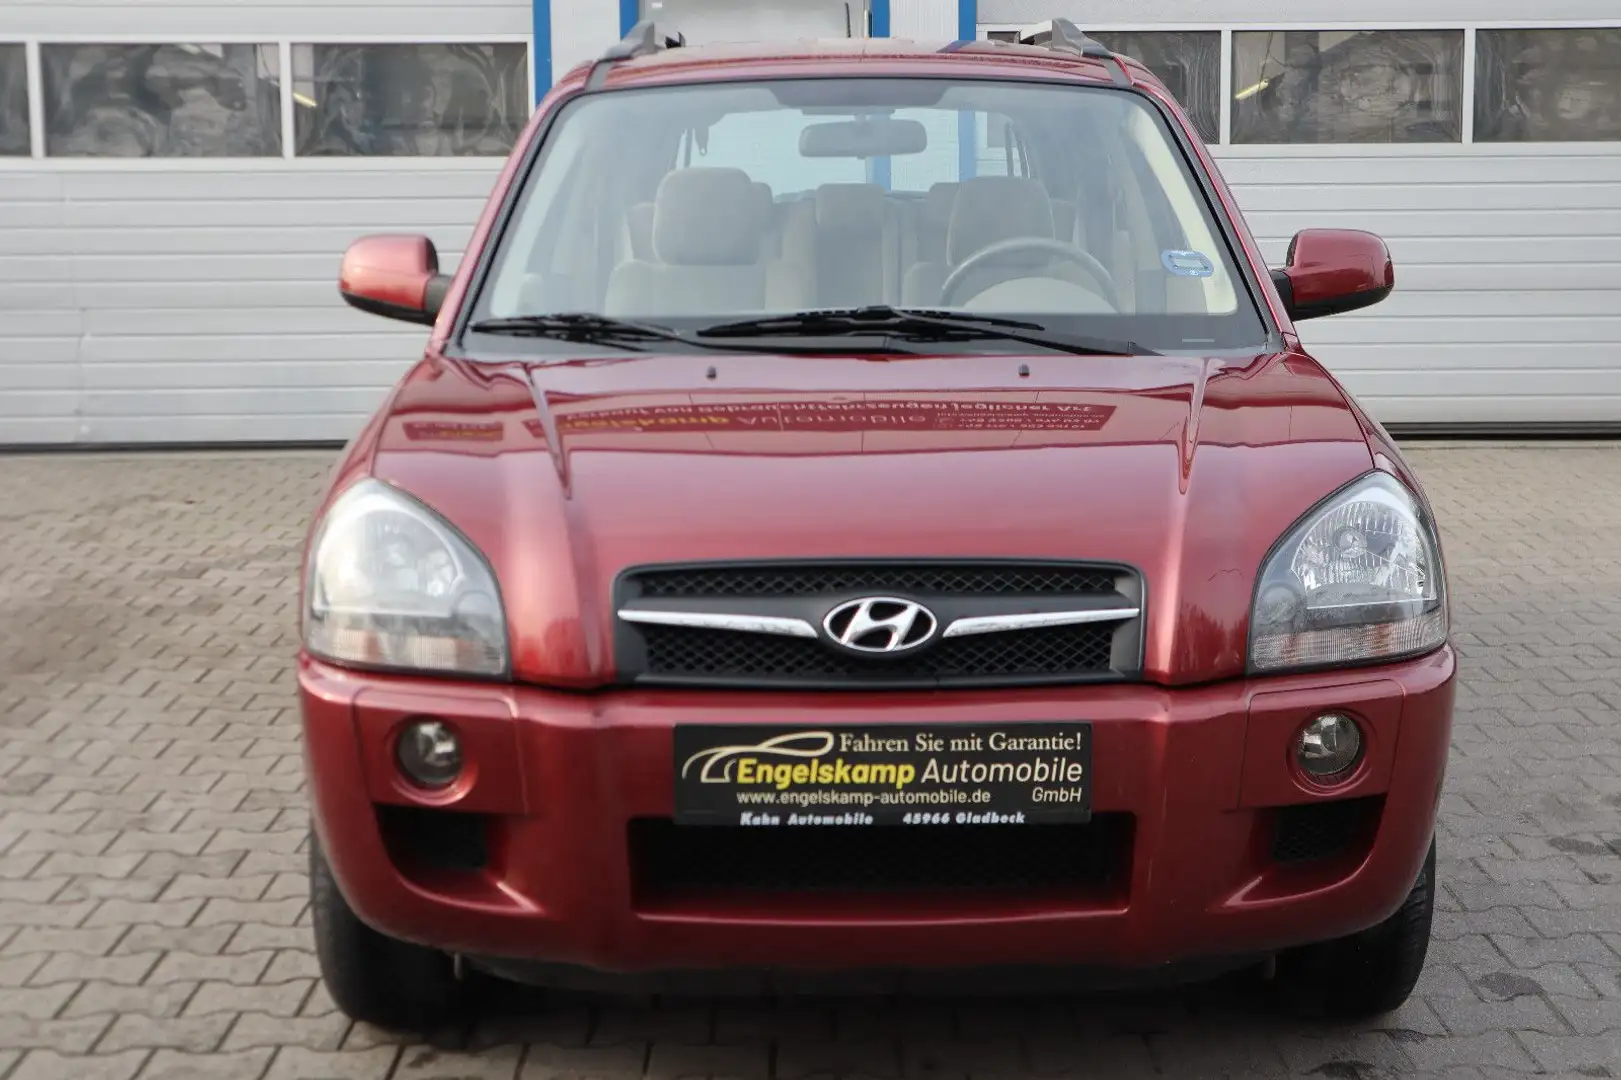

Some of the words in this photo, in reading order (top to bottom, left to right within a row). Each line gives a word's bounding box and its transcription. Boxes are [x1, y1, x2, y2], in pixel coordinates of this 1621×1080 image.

[840, 733, 909, 752] Fahren
[915, 733, 944, 751] Sie
[950, 733, 983, 751] mit
[989, 732, 1081, 751] Garantie!
[737, 758, 915, 789] Engelskamp
[921, 757, 1082, 783] Automobile
[737, 788, 990, 807] www.engelskamp-automobile.de
[1032, 787, 1082, 802] GmbH
[788, 812, 873, 825] Automobile
[903, 813, 950, 824] 45966
[956, 812, 1025, 823] Gladbeck
